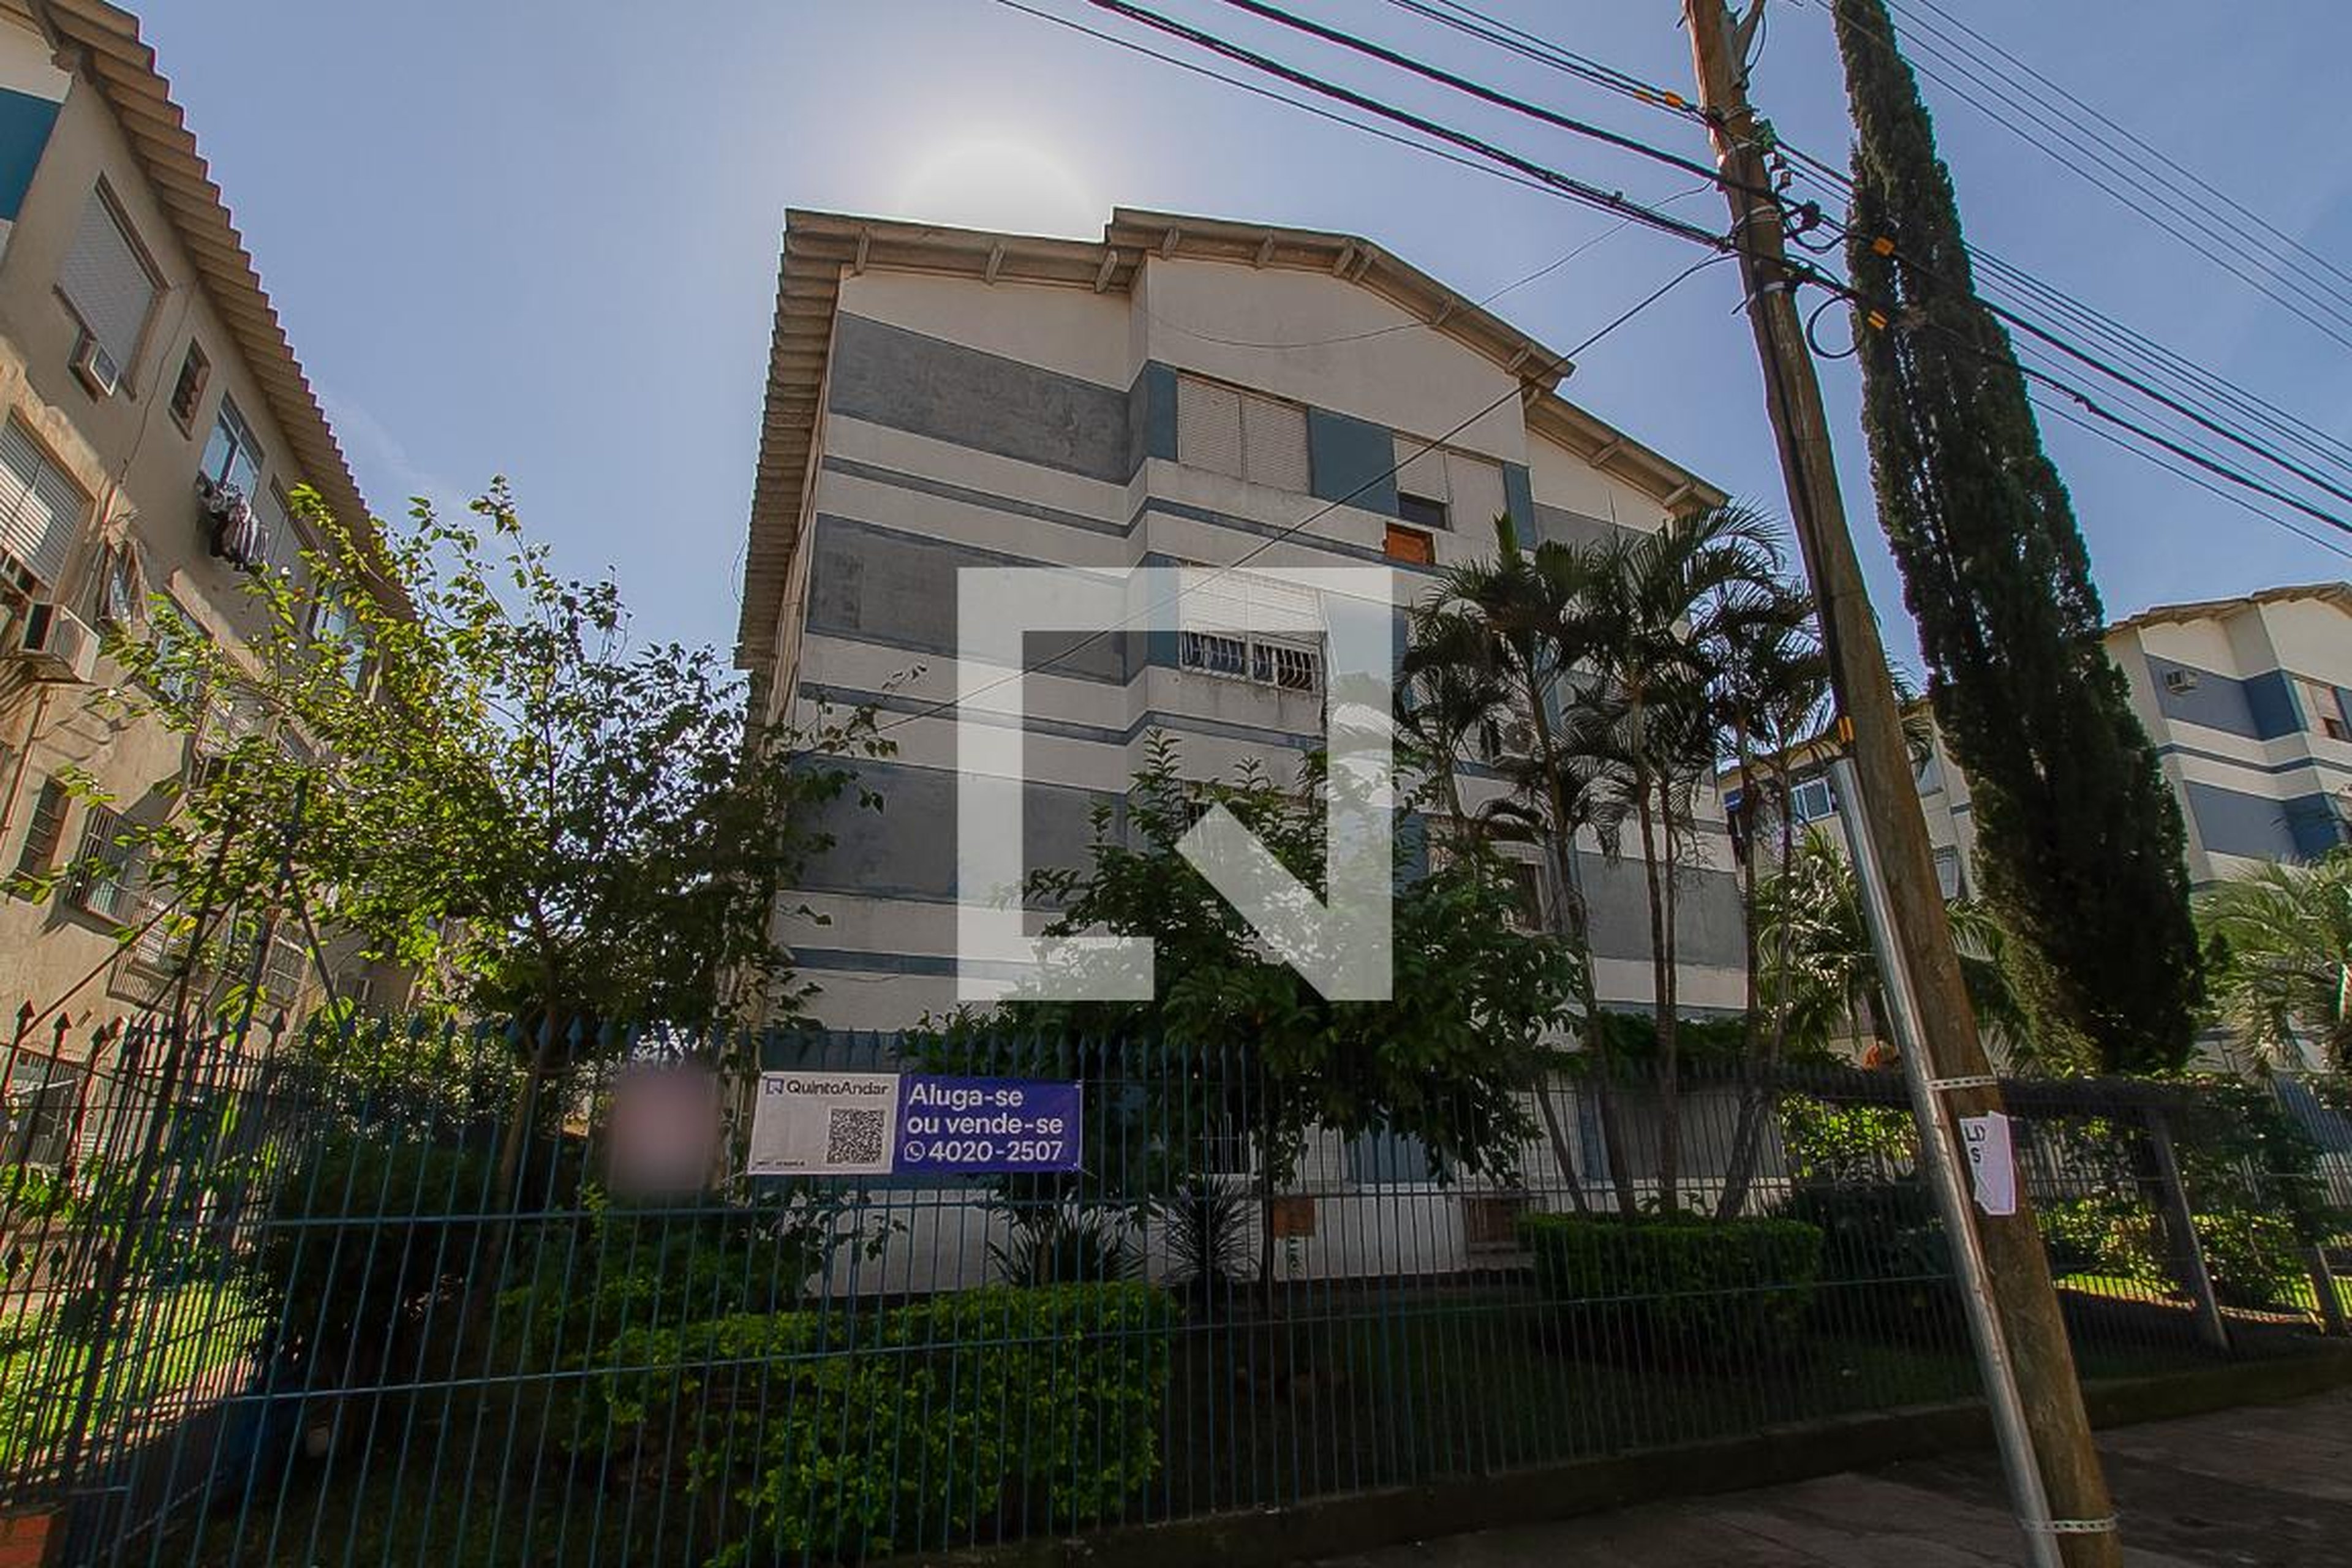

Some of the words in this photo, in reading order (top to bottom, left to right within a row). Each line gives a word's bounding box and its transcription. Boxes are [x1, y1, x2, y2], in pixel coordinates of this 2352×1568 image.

[787, 1080, 889, 1096] QuintoAndar
[908, 1083, 1023, 1111] Aluga-se
[907, 1116, 939, 1134] ou
[946, 1114, 1063, 1134] vende-se
[929, 1140, 1063, 1162] 4020-2507
